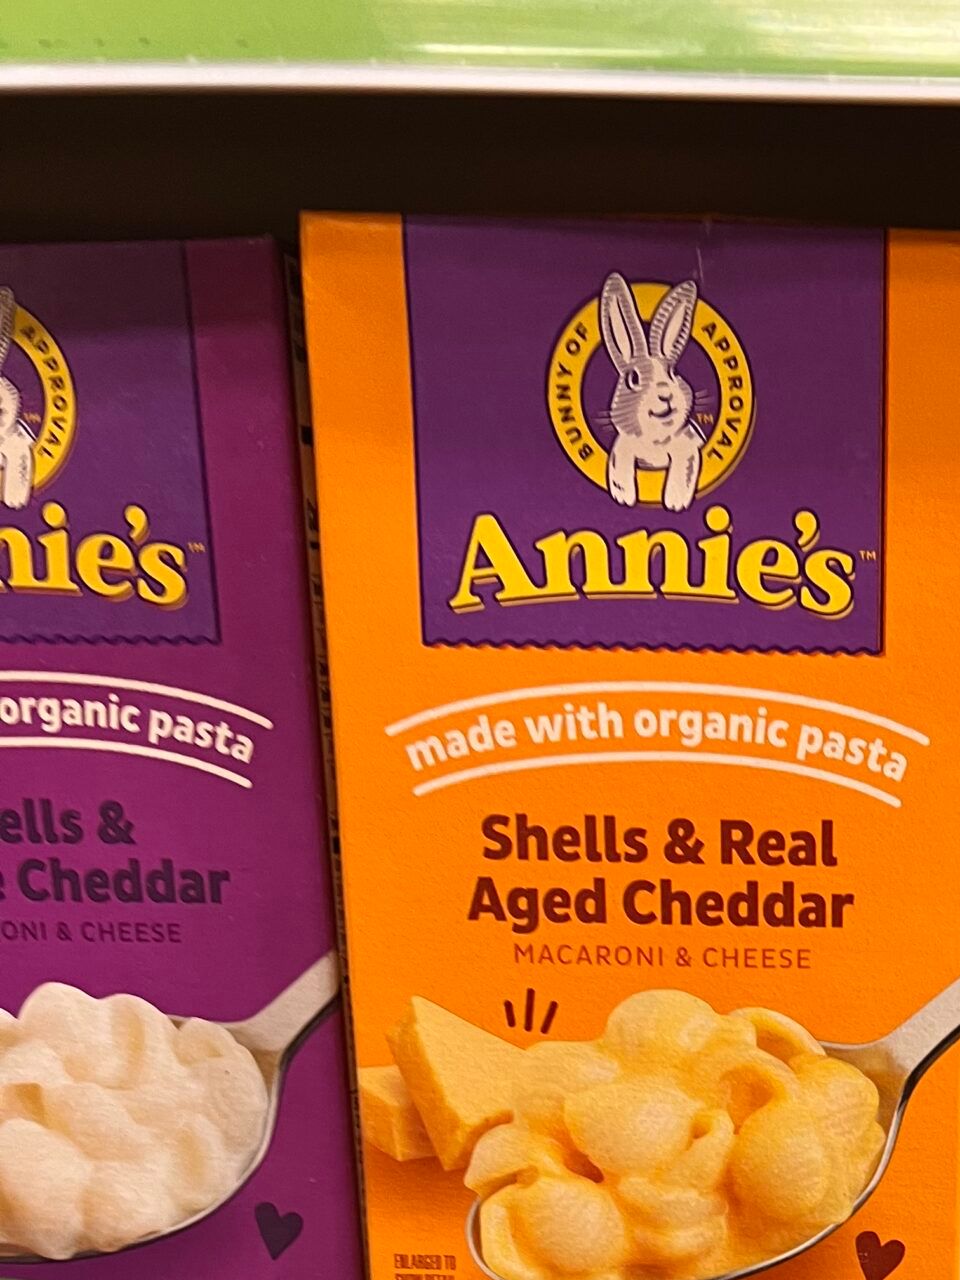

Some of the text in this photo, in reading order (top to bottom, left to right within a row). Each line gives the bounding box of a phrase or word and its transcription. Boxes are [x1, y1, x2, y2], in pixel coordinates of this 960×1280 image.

[448, 505, 856, 621] Annie's
[148, 709, 255, 763] pasta
[404, 702, 908, 781] made with organic pasta
[481, 814, 838, 867] Shells & Real
[18, 857, 231, 905] Cheddar
[468, 876, 855, 933] Aged Cheddar
